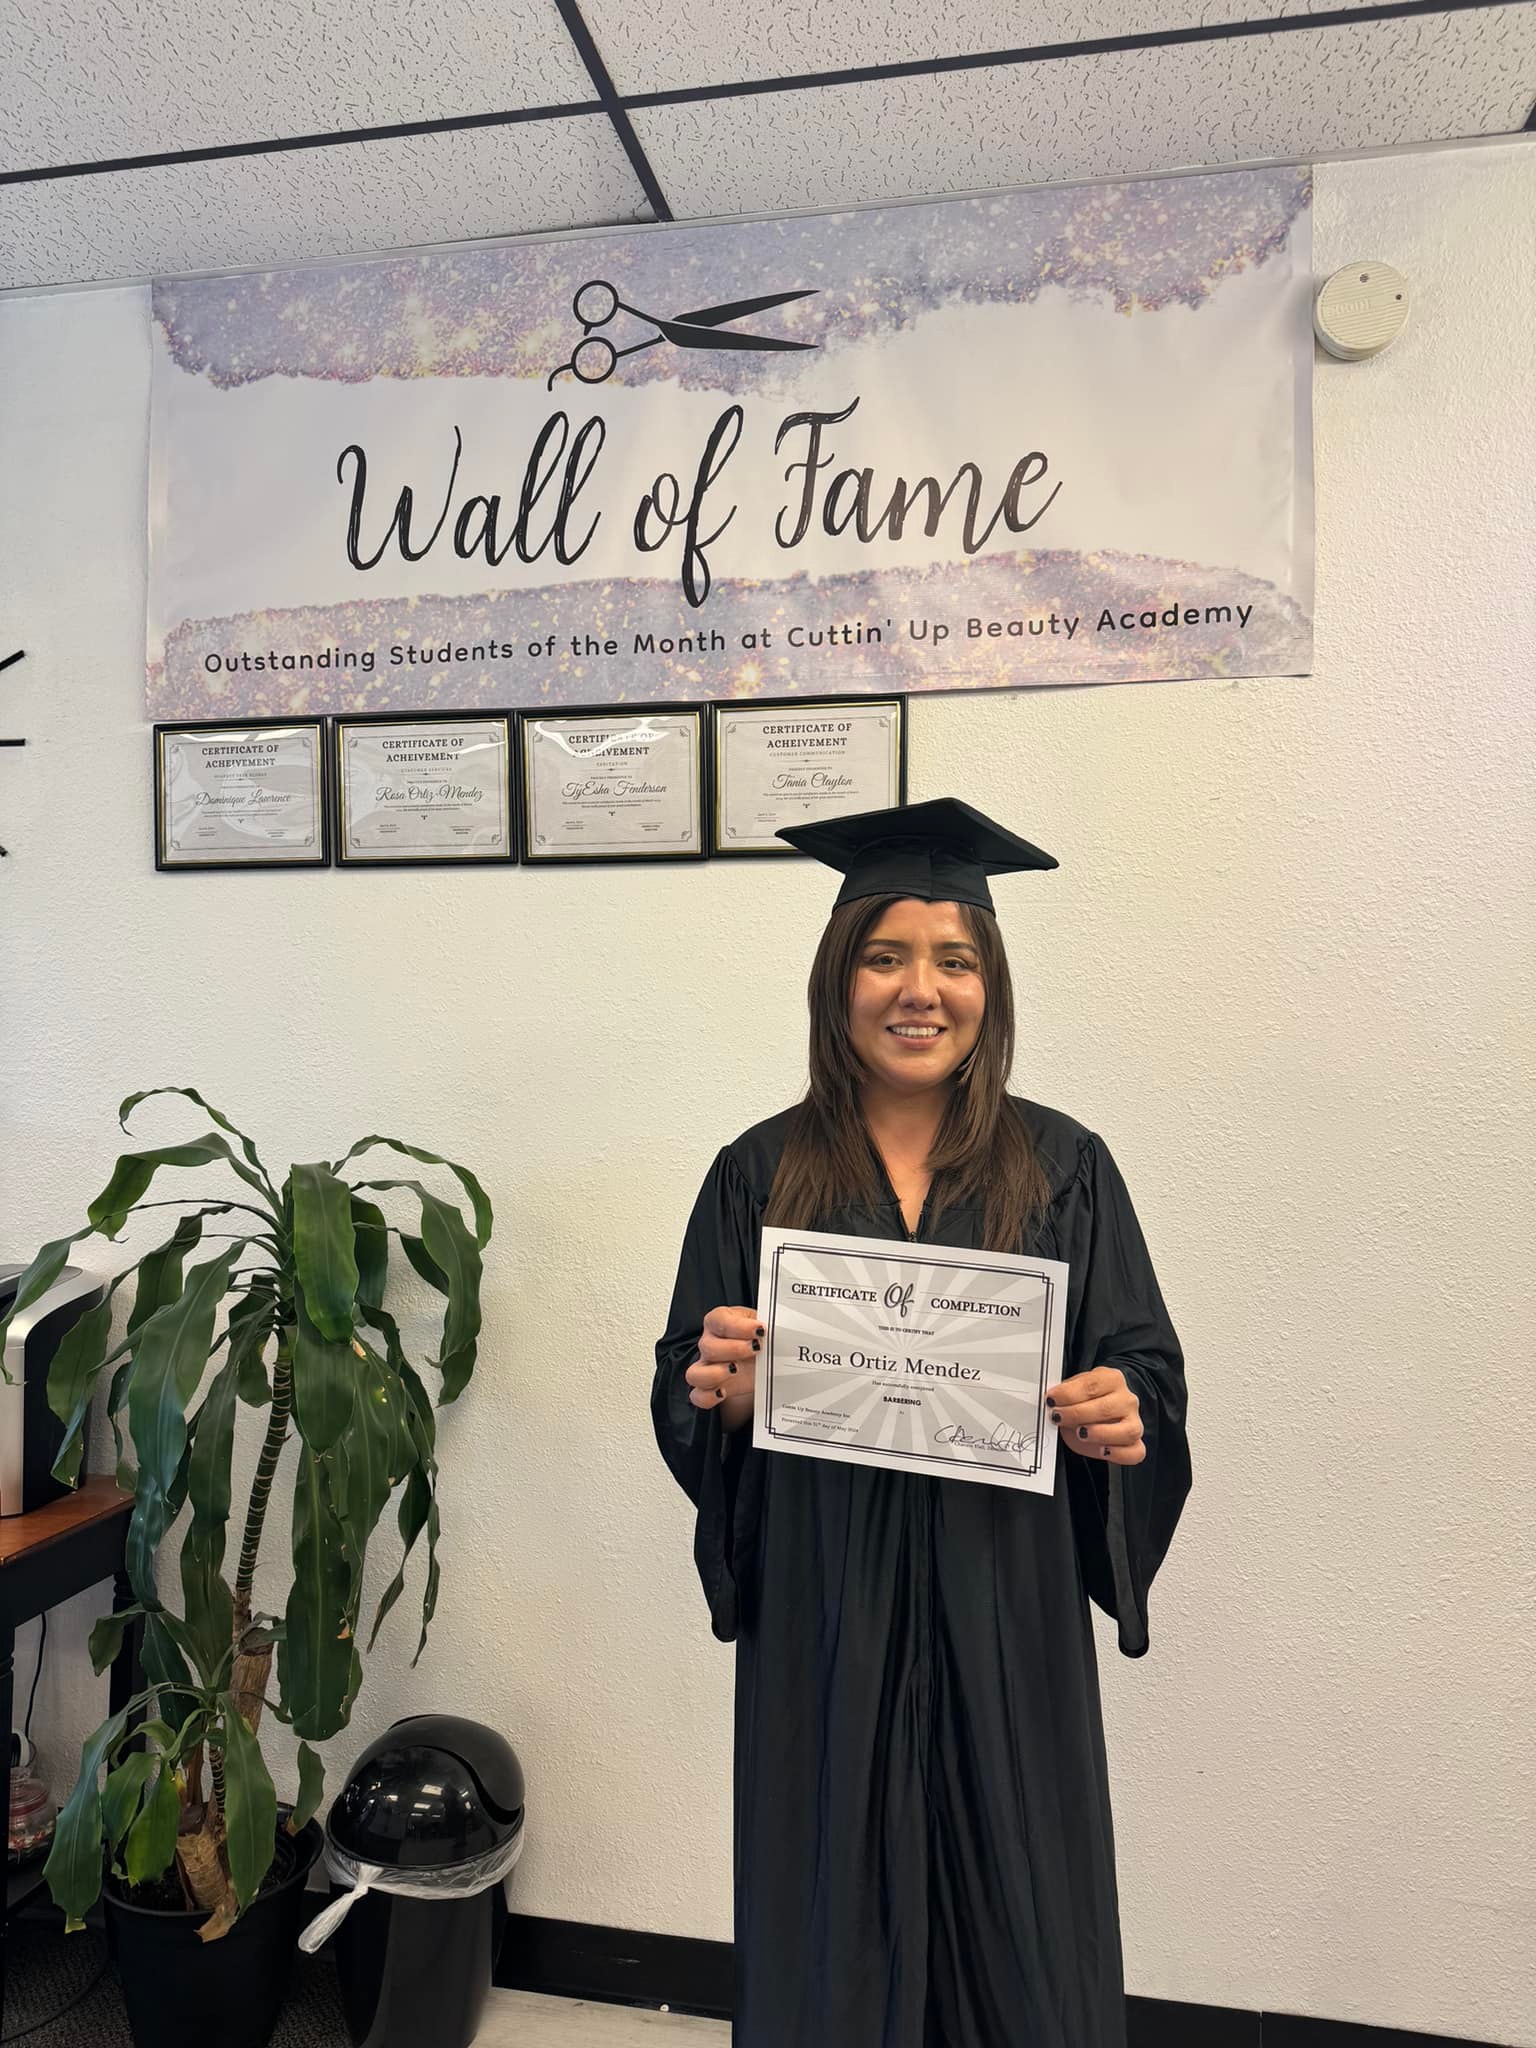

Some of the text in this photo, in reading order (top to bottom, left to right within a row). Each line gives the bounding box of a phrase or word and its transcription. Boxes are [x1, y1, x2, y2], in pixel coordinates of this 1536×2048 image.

[336, 396, 1063, 608] Wall of Fame
[204, 602, 1254, 673] Outstanding Students of the Month at Cuttin' Up Beauty Academy
[763, 723, 852, 734] CERTIFICATE OF
[382, 738, 464, 749] CERTIFICATE OF
[767, 737, 848, 748] ACHEIVEMENT
[202, 744, 280, 756] CERTIFICATE OF
[205, 758, 276, 769] ACHEIVEMENT
[386, 752, 460, 763] ACHEIVEMENT
[772, 772, 853, 791] Tania Clayton
[376, 786, 405, 801] Rosa
[562, 781, 610, 800] TyEsha
[792, 1282, 1021, 1318] CERTIFICATE Of COMPLETION
[798, 1346, 982, 1382] Rosa Ortiz Mendez
[883, 1396, 922, 1406] BARBERING
